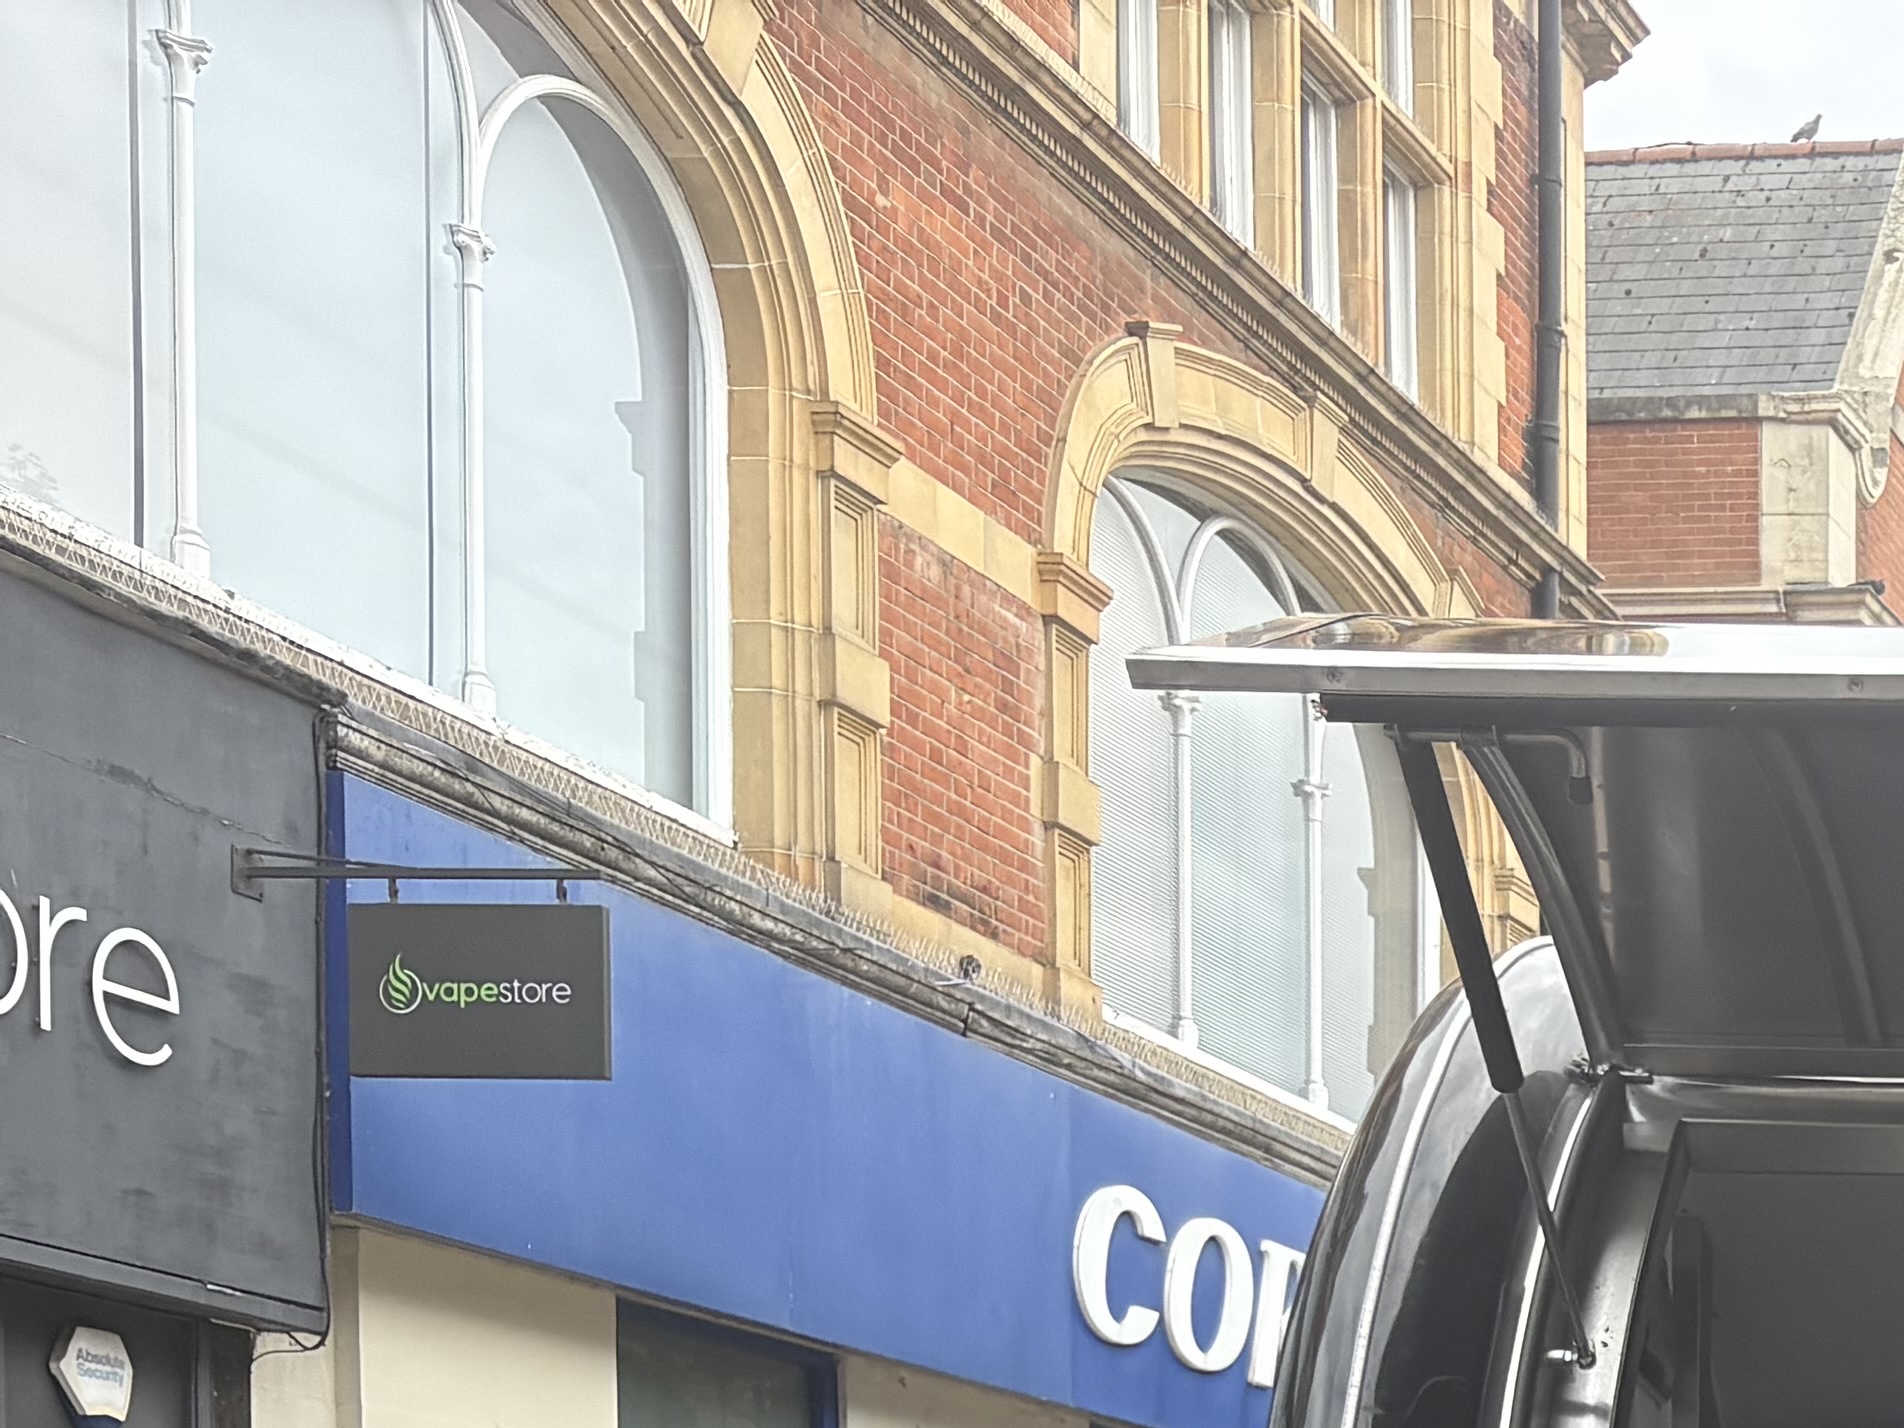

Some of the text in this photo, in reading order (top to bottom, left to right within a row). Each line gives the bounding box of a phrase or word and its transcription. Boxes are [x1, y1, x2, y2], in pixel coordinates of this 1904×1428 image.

[422, 978, 572, 1009] vapestore
[75, 1347, 126, 1371] Absolute
[76, 1362, 124, 1387] Security
